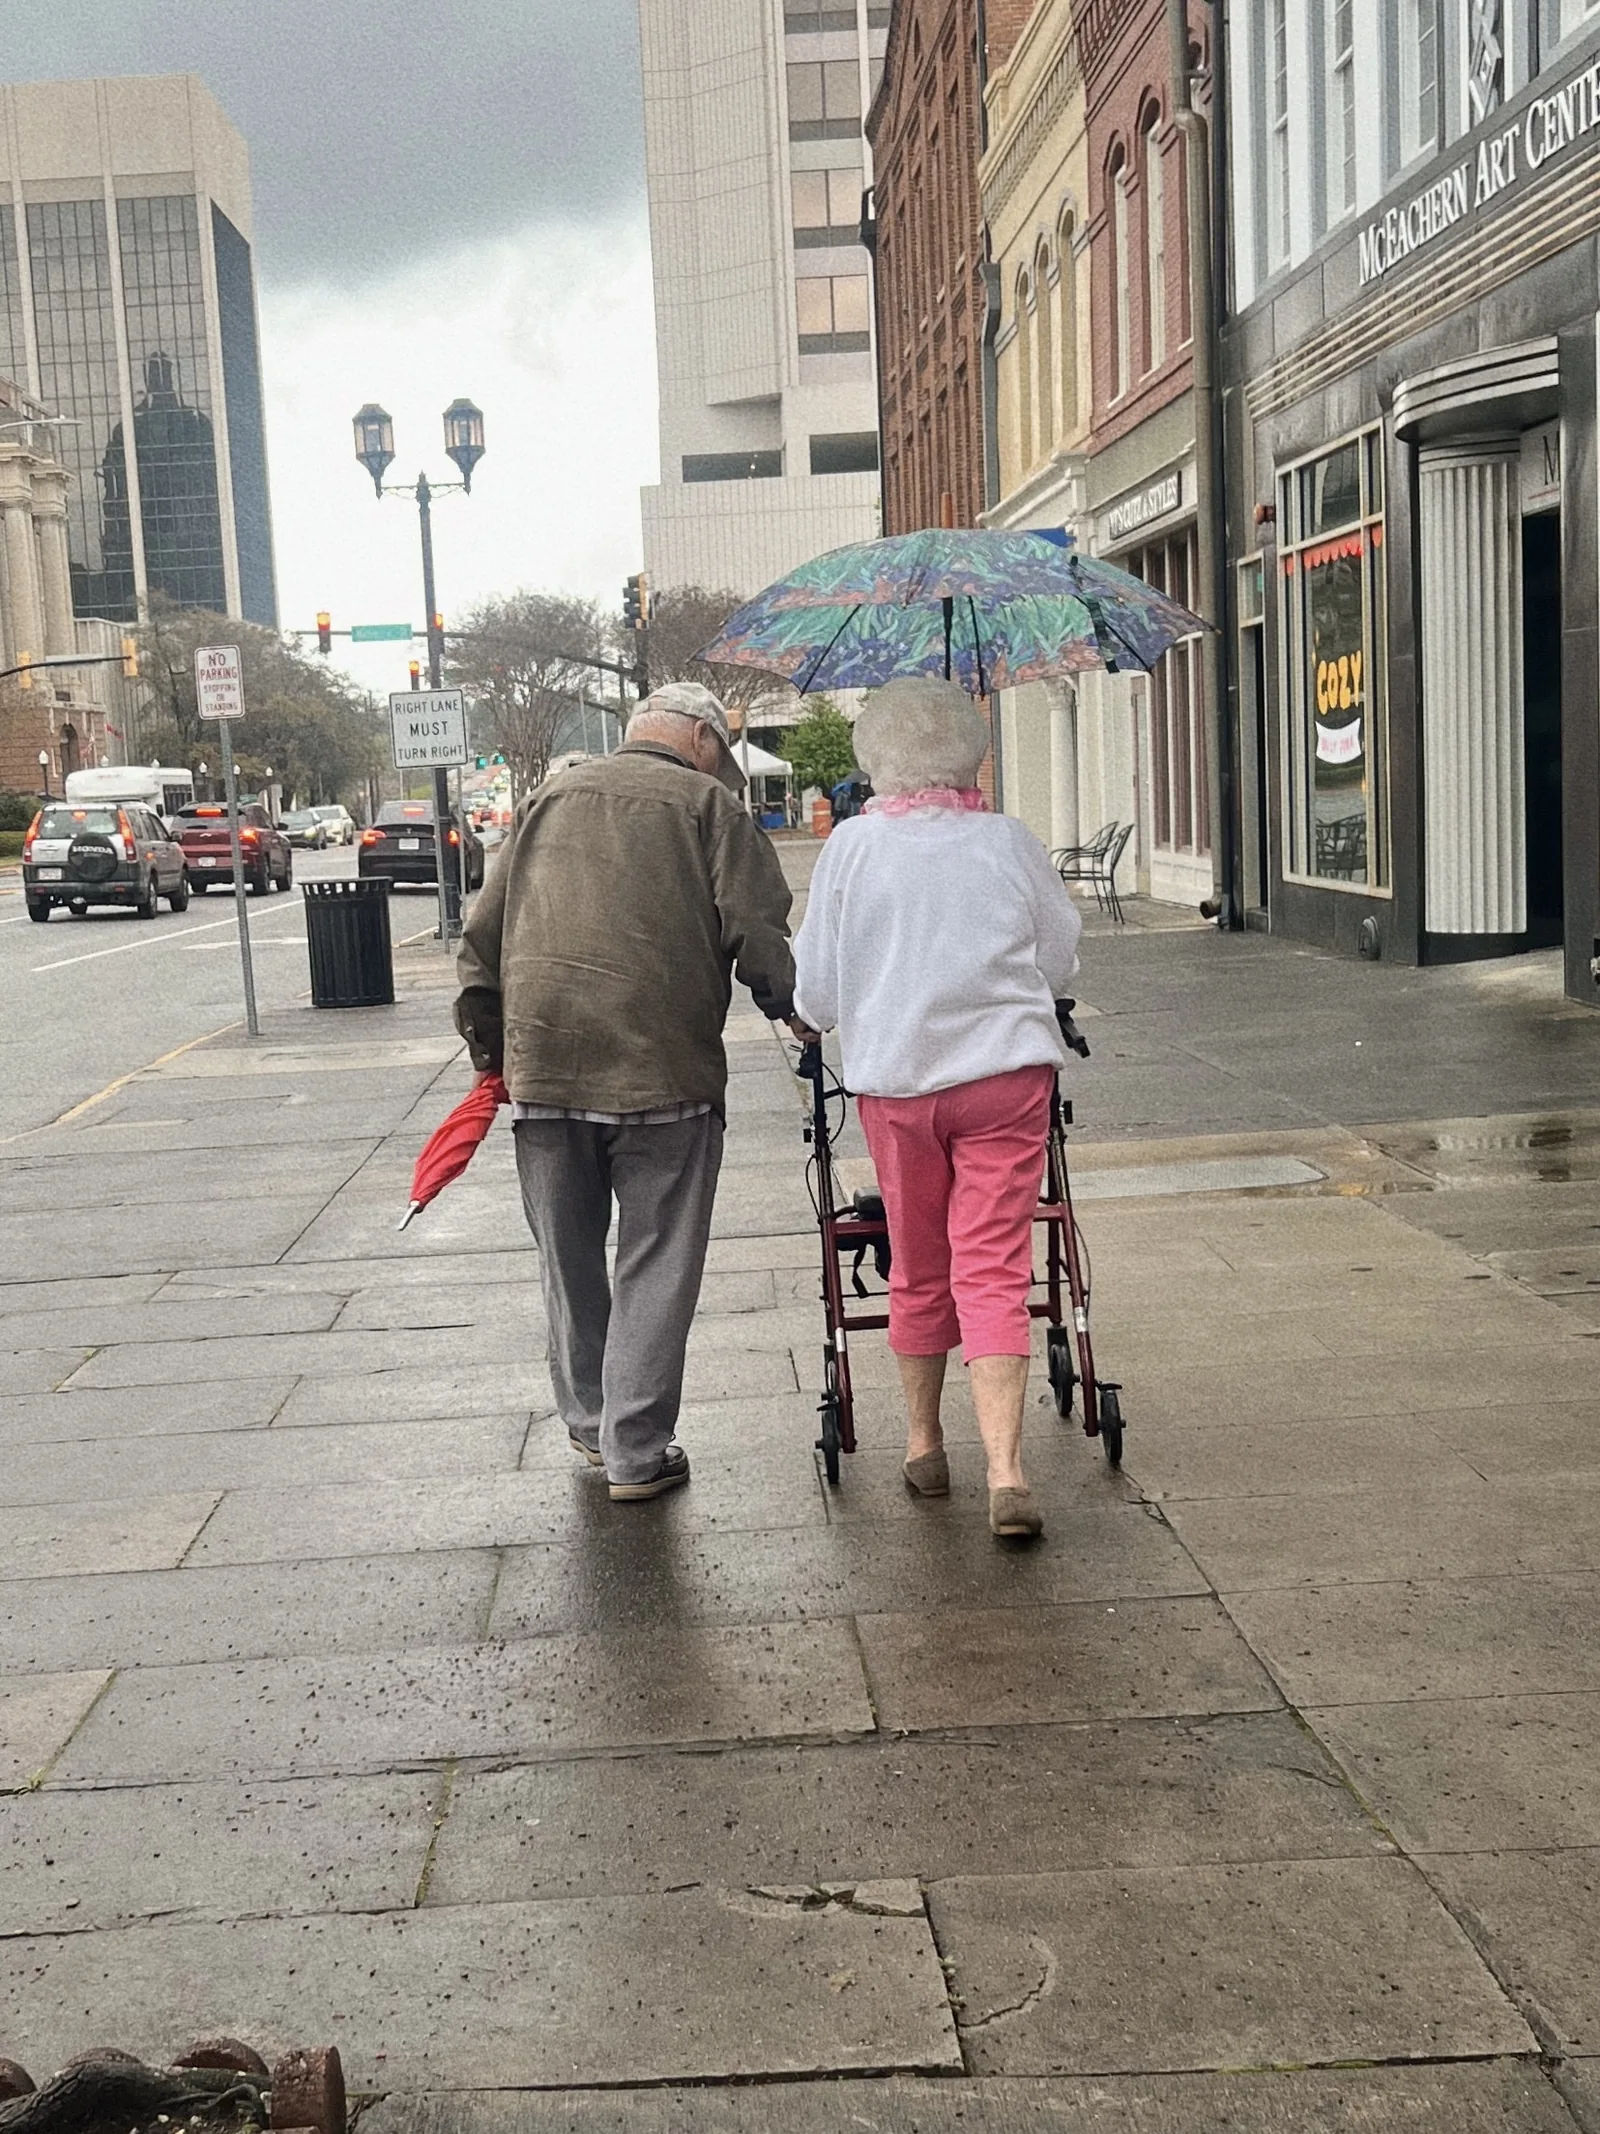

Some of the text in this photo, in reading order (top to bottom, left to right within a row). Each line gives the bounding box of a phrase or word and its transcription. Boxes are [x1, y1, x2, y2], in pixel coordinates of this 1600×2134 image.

[1474, 124, 1520, 208] ART
[208, 653, 226, 667] NO
[200, 666, 238, 681] PARKING
[203, 683, 237, 694] STOPPING
[1317, 650, 1361, 715] COZY
[205, 701, 238, 712] STANDING
[395, 699, 460, 714] RIGHT LANE
[410, 721, 448, 737] MUST
[398, 744, 463, 760] TURN RIGHT
[72, 845, 114, 854] HONDA
